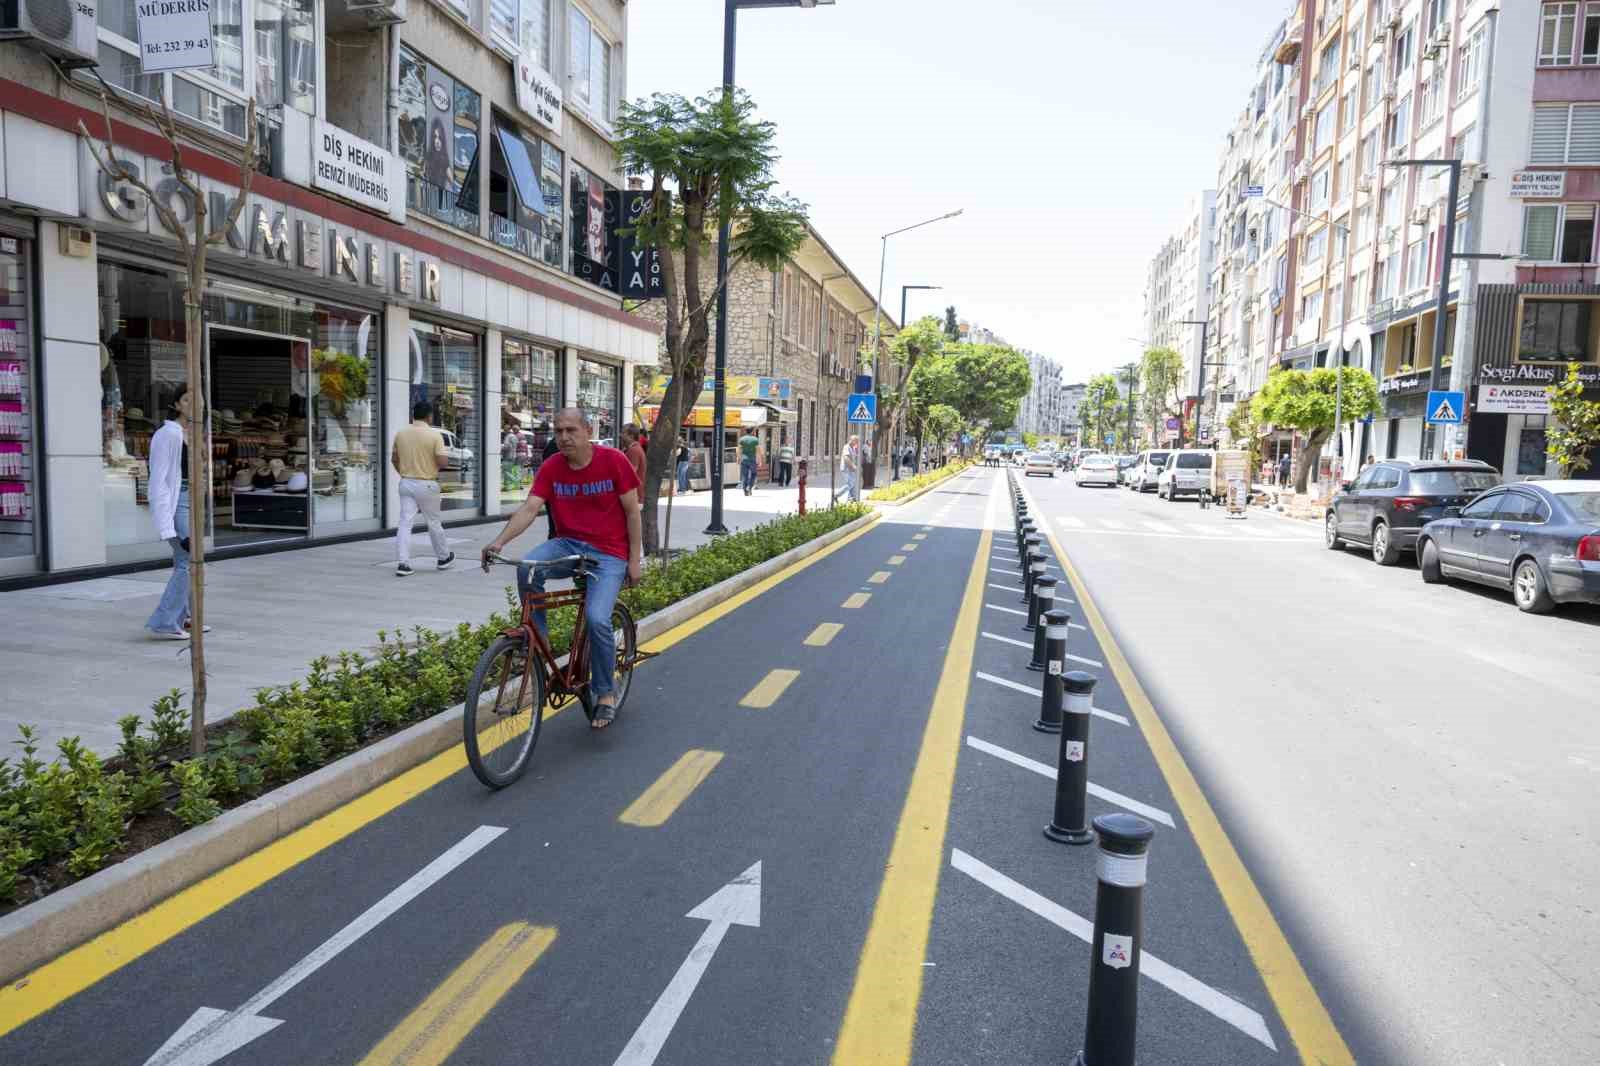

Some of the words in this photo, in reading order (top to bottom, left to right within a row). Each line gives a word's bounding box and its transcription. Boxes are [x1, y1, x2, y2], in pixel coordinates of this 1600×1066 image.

[164, 41, 181, 52] 232
[184, 40, 194, 50] 39
[197, 38, 209, 49] 43
[324, 133, 343, 161] DİŞ
[347, 145, 384, 177] HEKİMİ
[318, 159, 346, 187] REMZİ
[347, 172, 389, 203] MÜDERRİS
[1480, 362, 1516, 383] Sevgi
